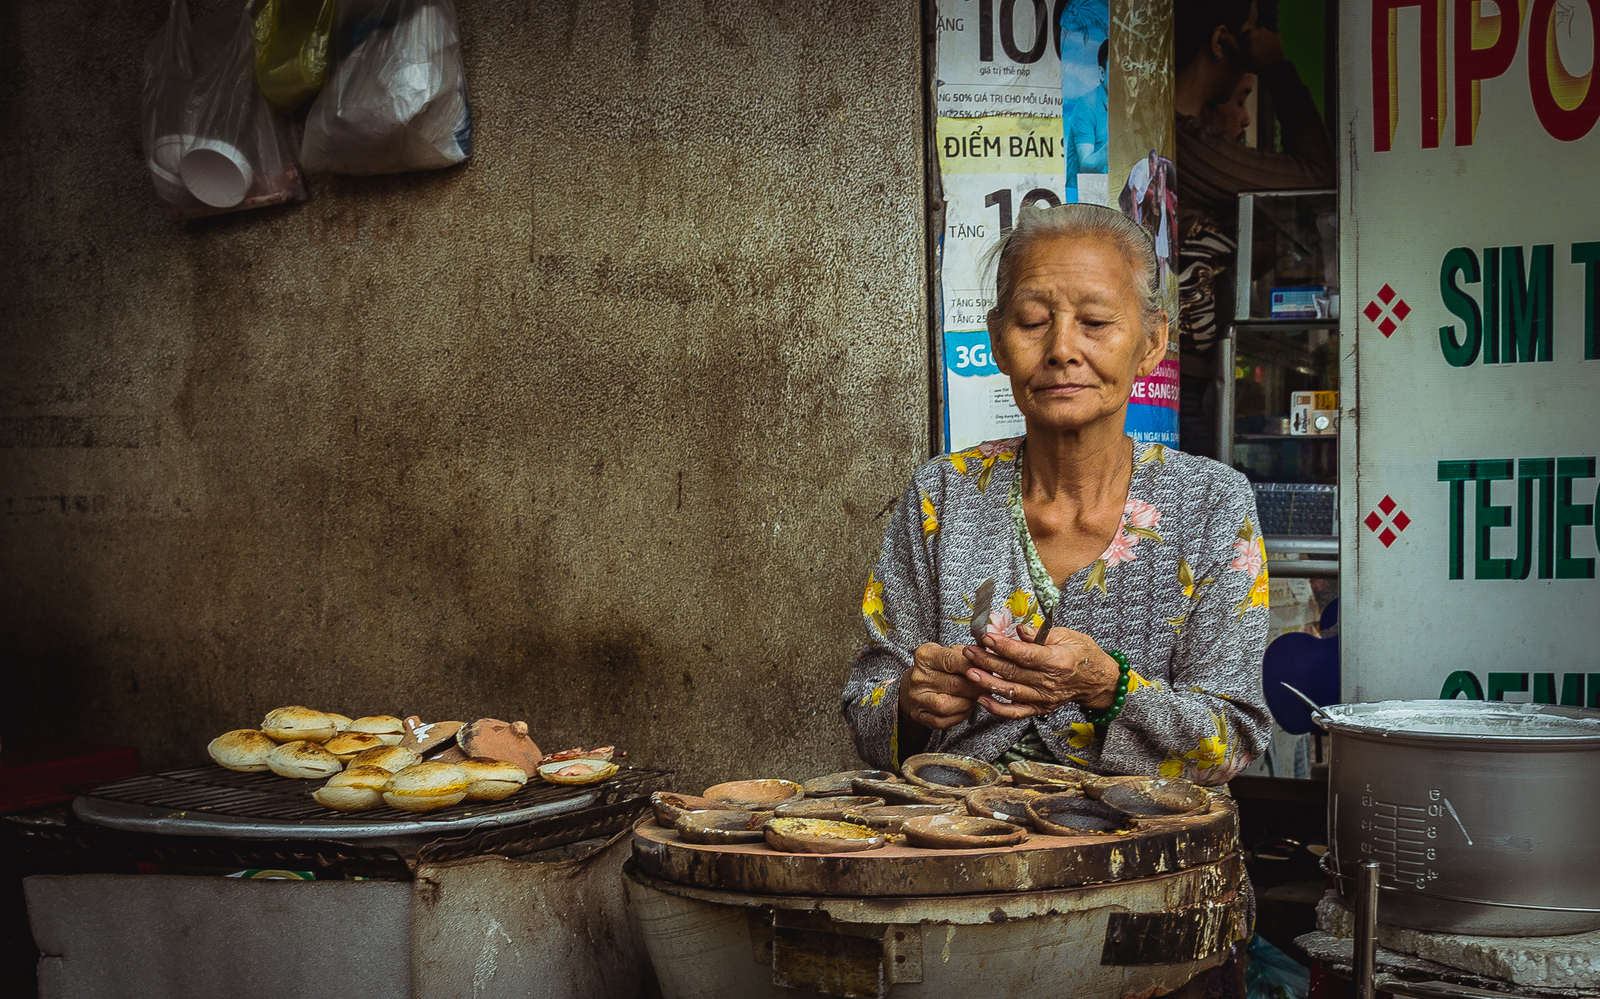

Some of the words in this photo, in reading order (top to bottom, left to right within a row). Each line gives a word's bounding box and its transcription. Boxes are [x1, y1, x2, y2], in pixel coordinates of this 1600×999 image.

[964, 0, 1062, 64] 10
[938, 93, 951, 102] NG
[953, 93, 972, 102] 50%
[974, 92, 988, 102] GIÁ
[1005, 94, 1020, 103] CHO
[944, 126, 1001, 157] ĐIỂM
[1009, 131, 1053, 157] BÁN
[949, 223, 984, 241] TẶNG
[1438, 244, 1554, 367] SIM
[1437, 457, 1600, 580] ТЕЛЕ
